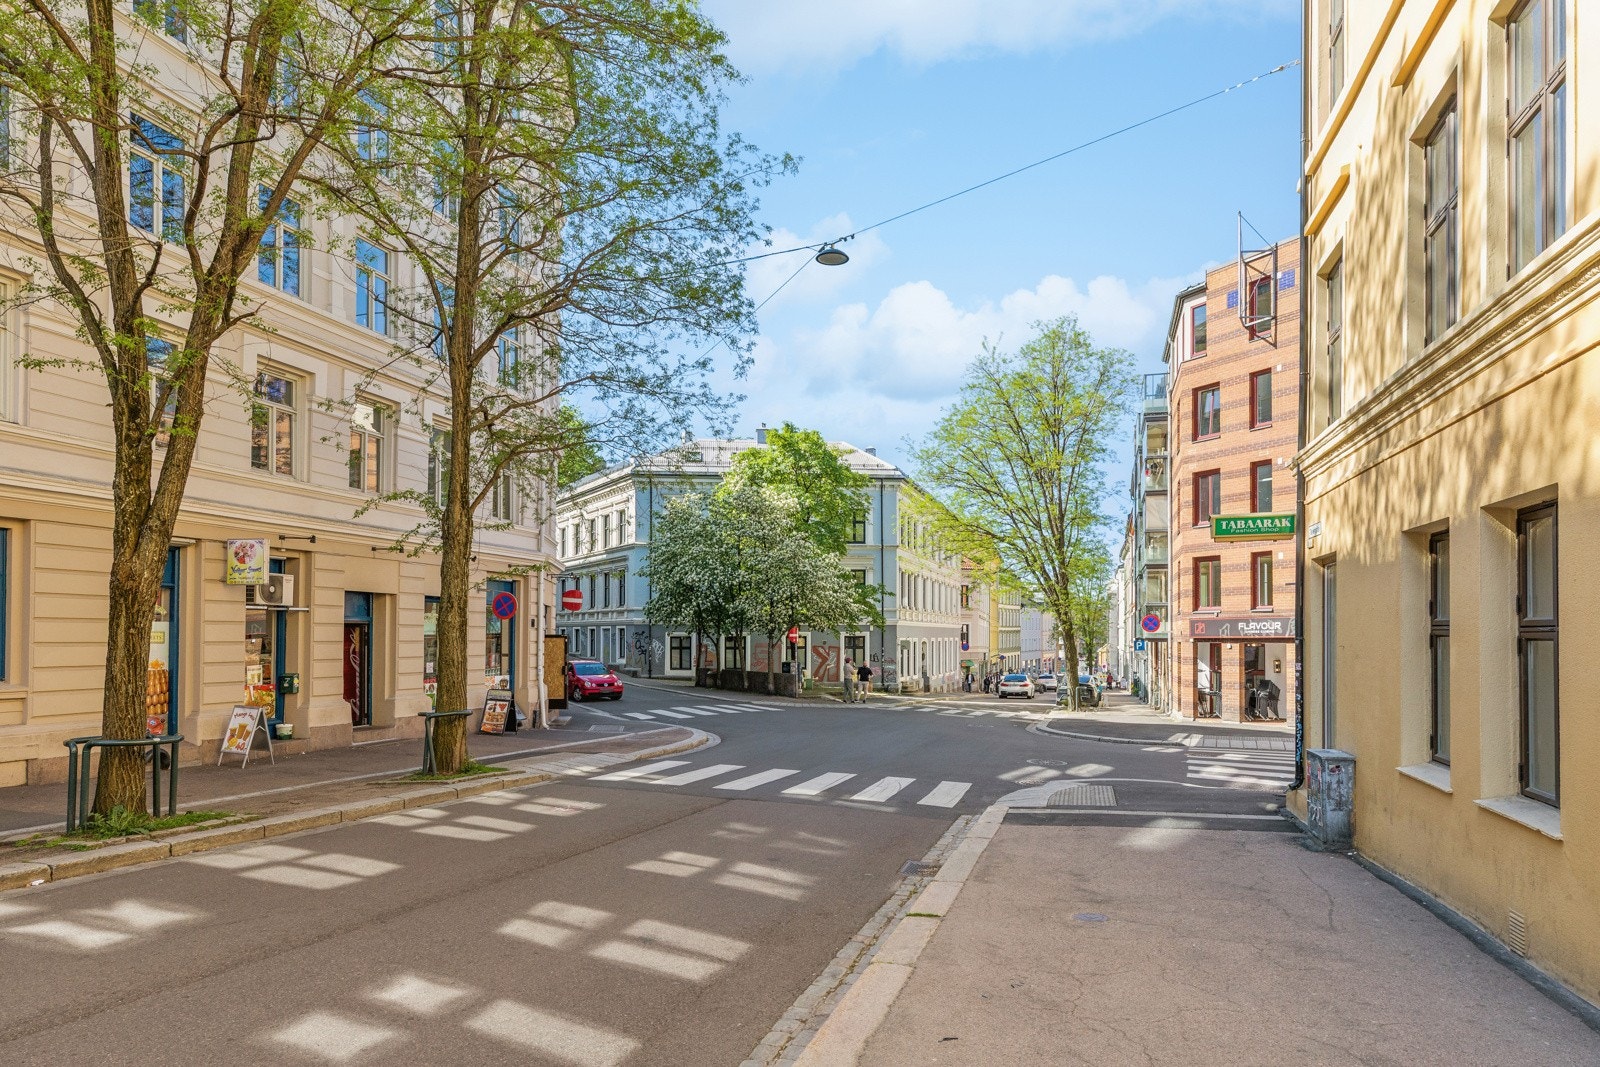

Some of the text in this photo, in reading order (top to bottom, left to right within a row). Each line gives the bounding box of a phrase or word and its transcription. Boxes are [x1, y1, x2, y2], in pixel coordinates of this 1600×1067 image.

[1220, 517, 1292, 530] TABAARAK
[1238, 621, 1282, 631] FLAVOUR
[1135, 641, 1143, 650] P
